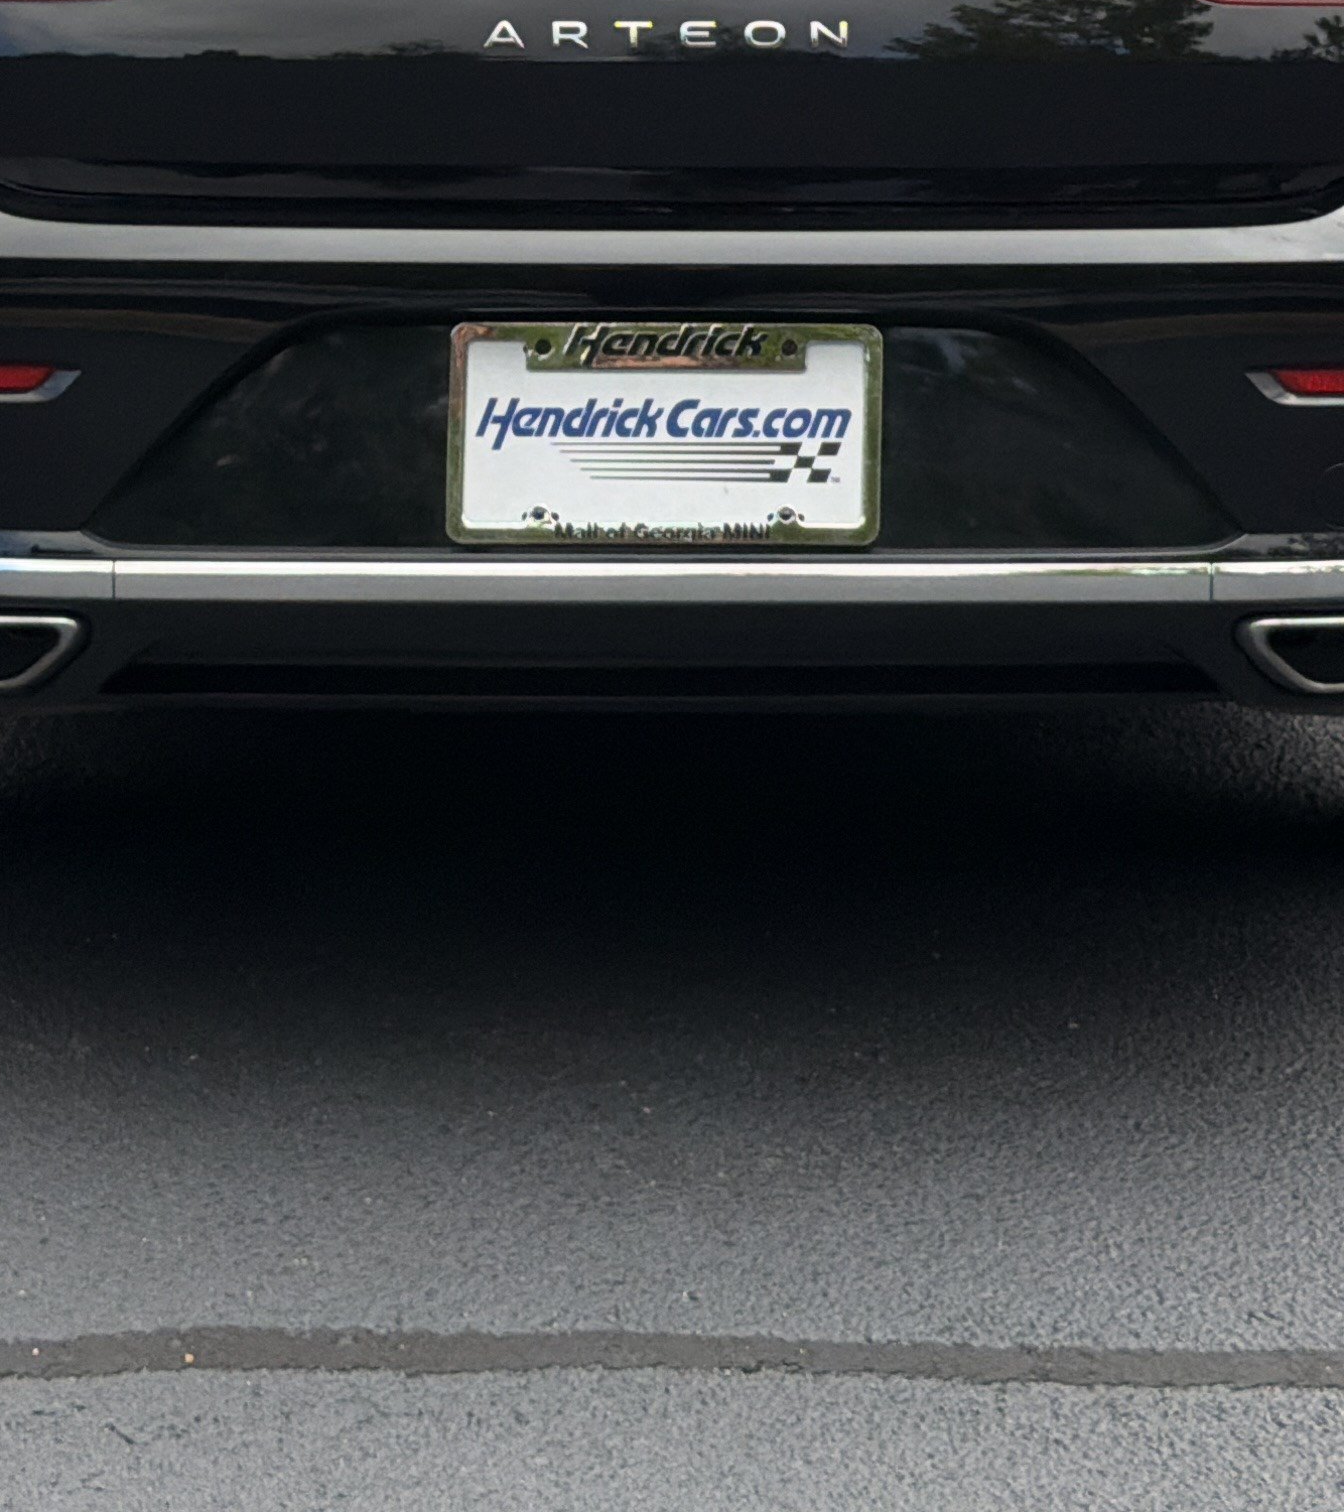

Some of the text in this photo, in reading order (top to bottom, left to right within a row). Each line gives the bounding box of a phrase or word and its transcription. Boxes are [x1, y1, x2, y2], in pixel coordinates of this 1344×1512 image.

[483, 20, 849, 49] ARTEON
[563, 323, 768, 367] Hendrick
[555, 522, 771, 543] Mall of Georgia MINI
